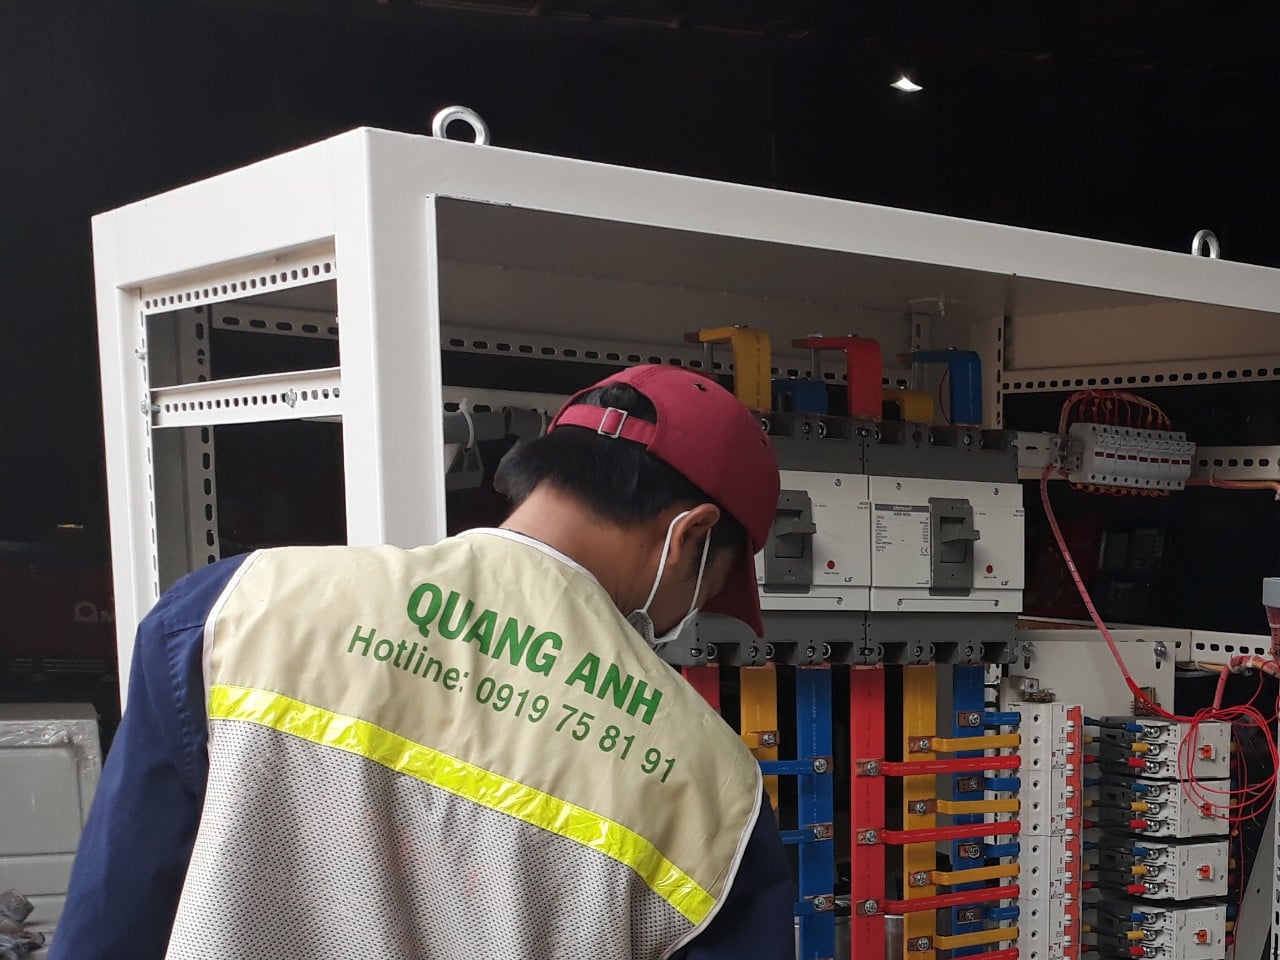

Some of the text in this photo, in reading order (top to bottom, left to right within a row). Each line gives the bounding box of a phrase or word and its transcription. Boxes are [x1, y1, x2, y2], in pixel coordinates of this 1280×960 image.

[347, 625, 676, 783] Hotline: 0919 75 81 91
[406, 582, 664, 725] QUANG ANH
